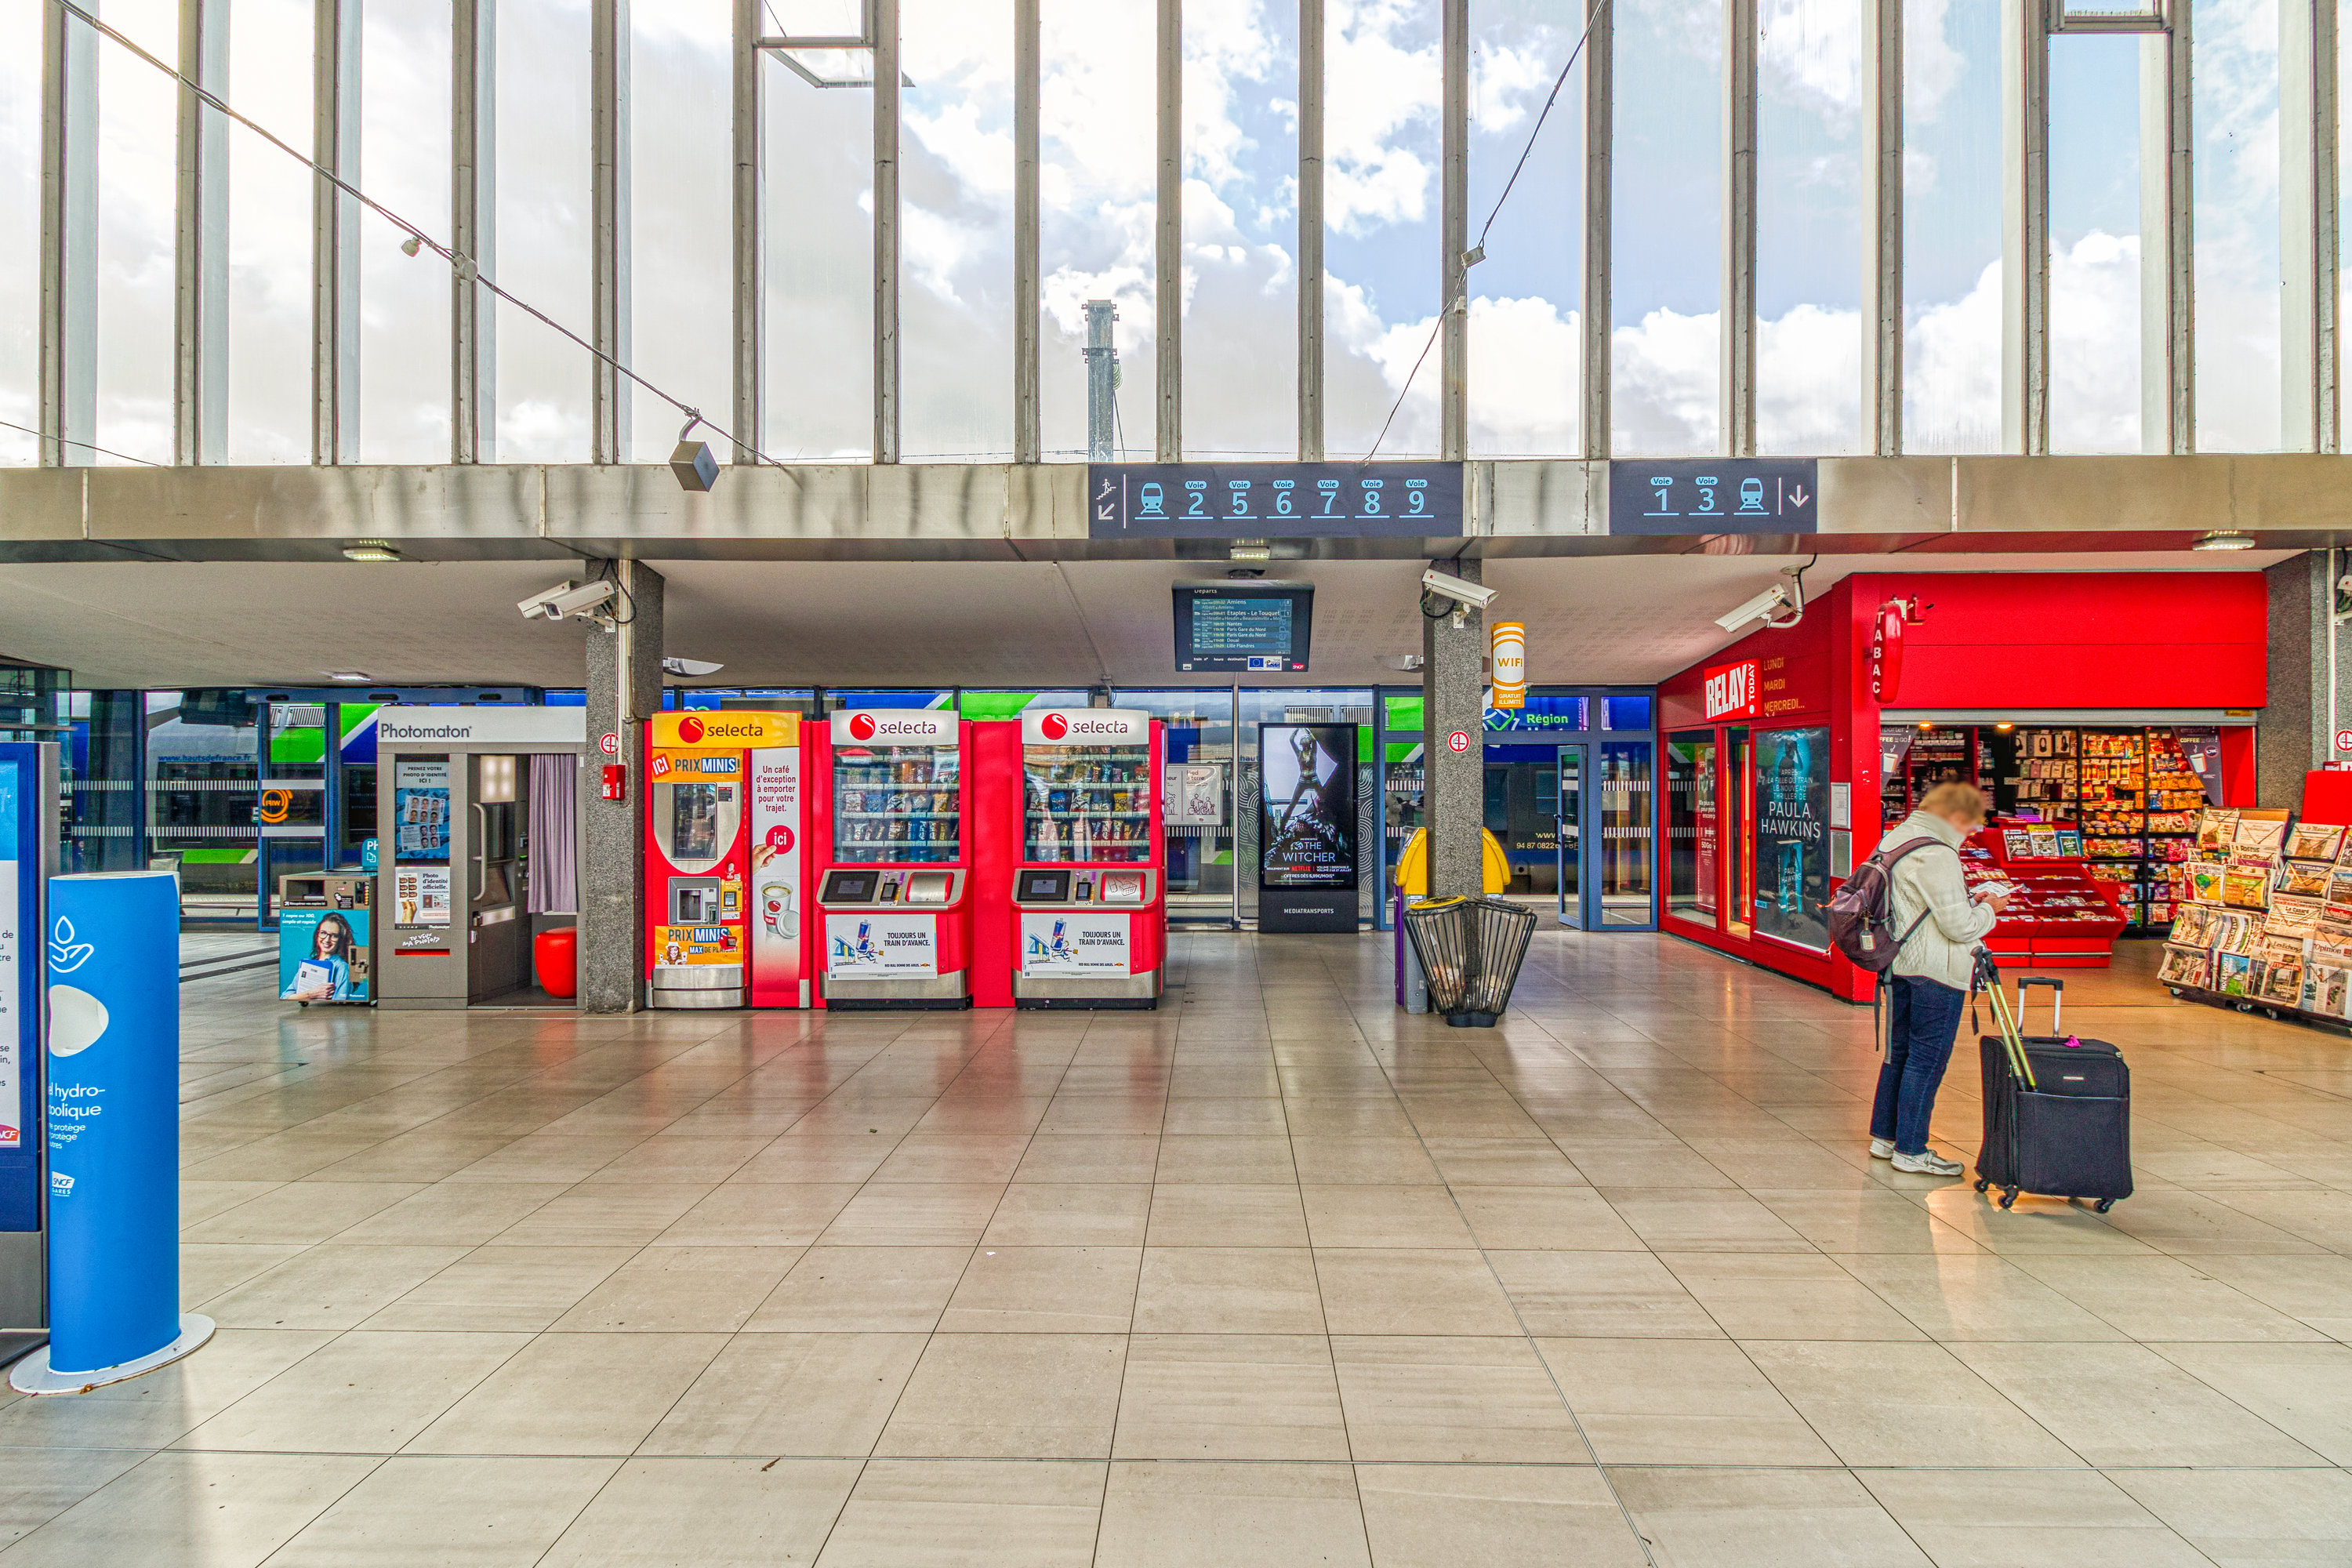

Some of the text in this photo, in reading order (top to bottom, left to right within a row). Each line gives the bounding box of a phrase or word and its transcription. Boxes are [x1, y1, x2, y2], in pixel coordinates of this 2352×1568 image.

[1188, 481, 1205, 489] Voie
[1232, 481, 1249, 489] Voie
[1320, 480, 1337, 488] Voie
[1408, 479, 1425, 488] Voie
[1189, 492, 1204, 515] 2
[1232, 492, 1249, 515] 5
[1276, 491, 1292, 514] 6
[1319, 492, 1337, 514] 7
[1363, 490, 1381, 514] 8
[1408, 490, 1425, 514] 9
[1654, 488, 1668, 511] 1
[1698, 488, 1715, 511] 3
[1873, 612, 1885, 694] TABAC
[1497, 658, 1523, 667] WIFI
[1764, 658, 1784, 670] LUNDI
[1706, 663, 1747, 719] RELAY
[1764, 678, 1785, 691] MARDI
[1764, 699, 1805, 712] MERCREDI...
[1527, 713, 1568, 725] Région
[380, 724, 471, 738] Photomaton
[707, 724, 763, 737] selecta
[879, 721, 937, 734] selecta
[1072, 720, 1128, 734] selecta
[652, 757, 669, 775] ICI
[675, 759, 700, 772] PRIX
[774, 765, 789, 774] café
[756, 775, 797, 786] d'exception
[764, 786, 796, 794] emporter
[758, 796, 774, 804] pour
[765, 804, 787, 814] trajet.
[1769, 801, 1810, 818] PAULA
[1761, 818, 1820, 838] HAWKINS
[774, 832, 787, 845] ici
[1283, 852, 1336, 862] WITCHER
[669, 929, 692, 942] PRIX
[55, 1083, 105, 1102] hydro-
[53, 1178, 72, 1186] SNCF
